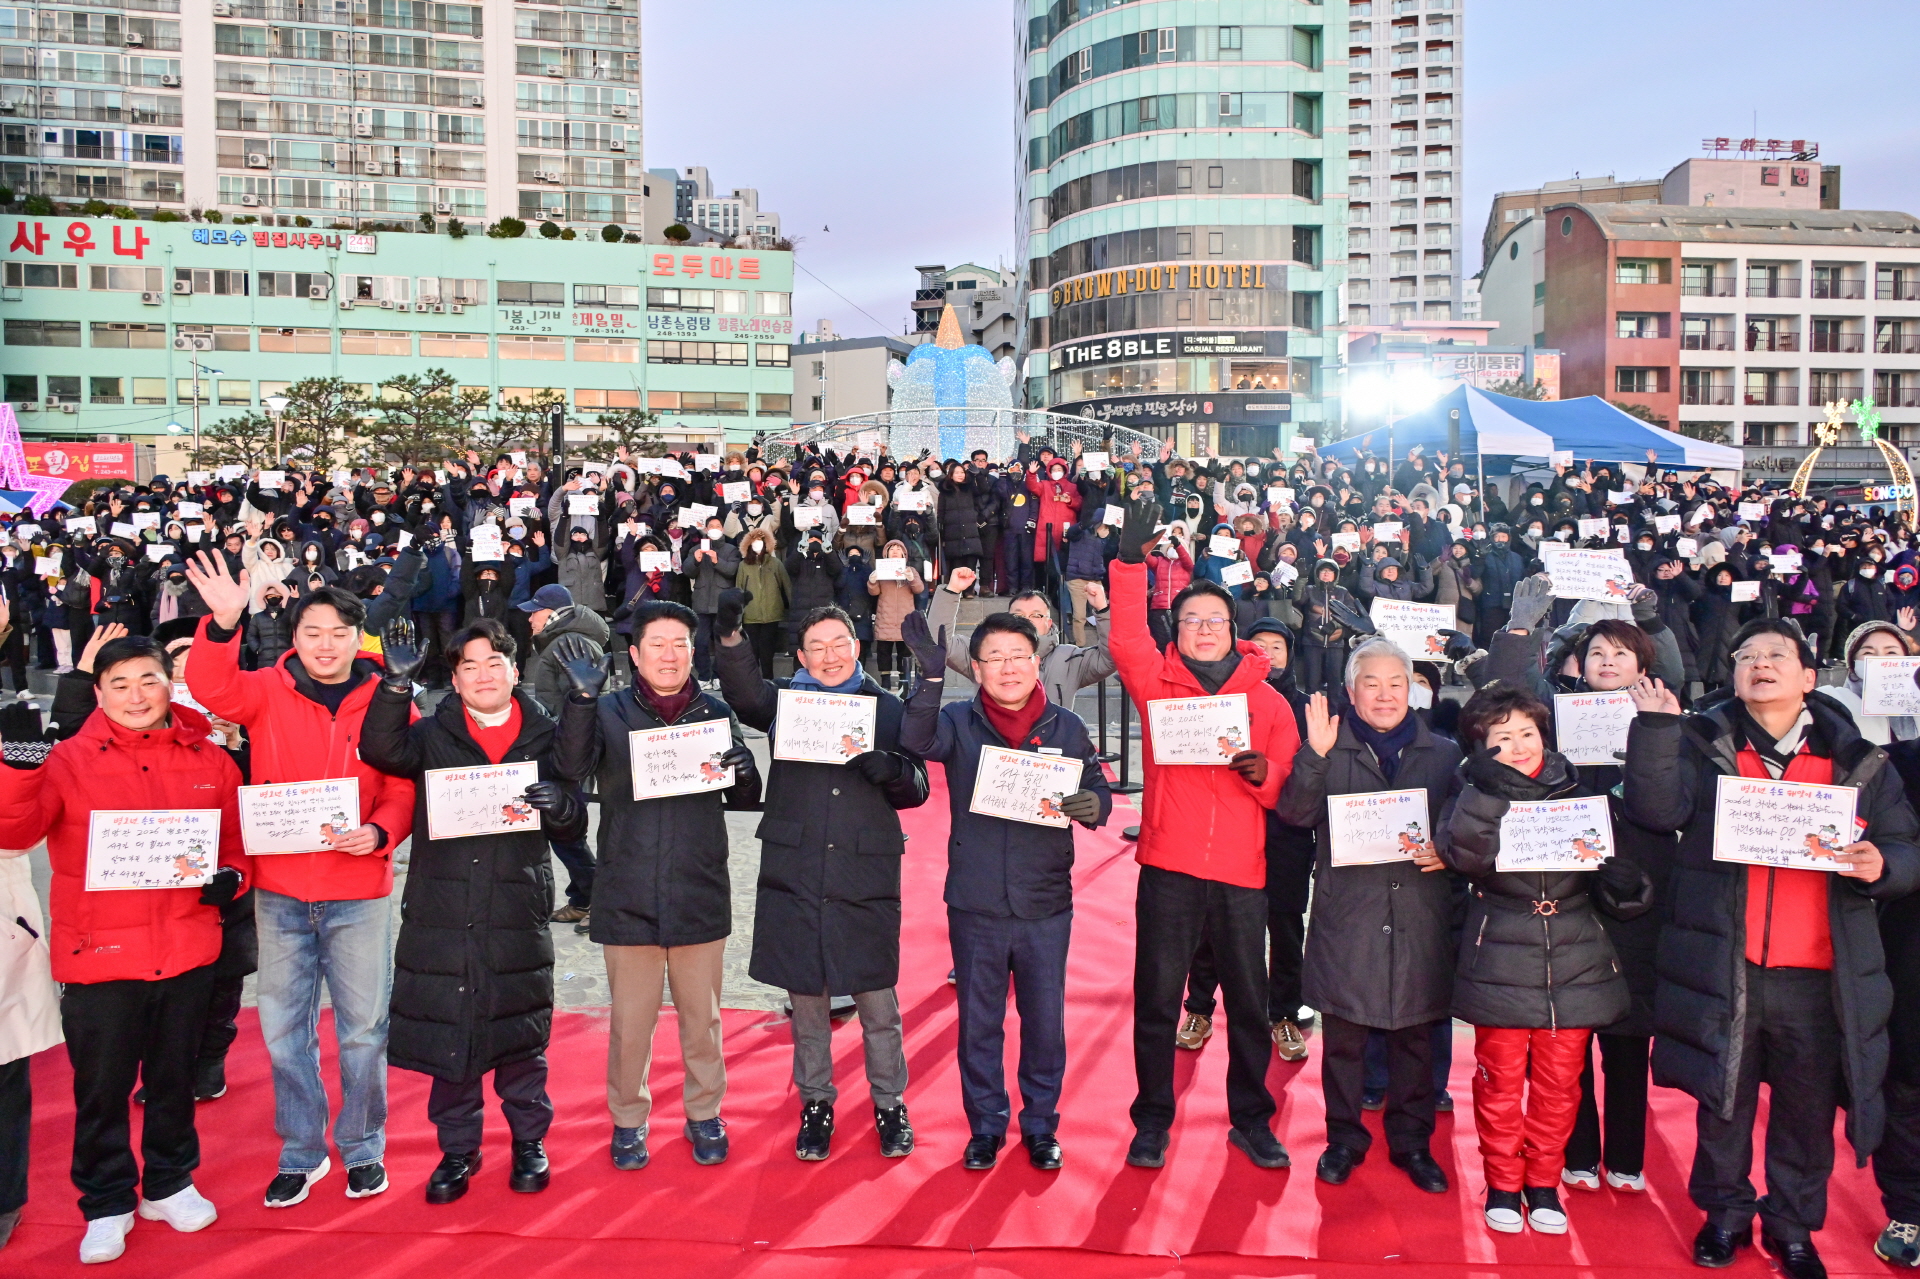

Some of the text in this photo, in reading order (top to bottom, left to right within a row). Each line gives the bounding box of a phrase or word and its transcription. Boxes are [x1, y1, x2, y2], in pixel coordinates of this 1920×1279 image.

[10, 221, 150, 260] 사우나
[192, 228, 373, 251] 해모수 찜질사우나 24시
[652, 253, 761, 279] 모두마트
[1188, 264, 1267, 289] HOTEL
[1066, 338, 1172, 364] THE 8BLE
[1184, 345, 1264, 353] CASUAL RESTAURANT
[173, 441, 191, 450] 송도
[816, 697, 827, 706] 송도
[848, 700, 861, 708] 축제
[1186, 702, 1197, 711] 송도
[1199, 701, 1218, 709] 해맞이
[1220, 700, 1232, 708] 축제
[1595, 697, 1606, 706] 송도
[1579, 707, 1624, 720] 2026
[669, 732, 681, 740] 송도
[682, 729, 700, 738] 해맞이
[703, 727, 715, 735] 축제
[1020, 758, 1031, 766] 송도
[1033, 761, 1051, 770] 해맞이
[1053, 764, 1066, 772] 축제
[469, 771, 481, 780] 송도
[483, 770, 503, 778] 해맞이
[505, 768, 519, 777] 축제
[285, 788, 298, 797] 송도
[300, 785, 322, 795] 해맞이
[324, 785, 339, 793] 축제
[1741, 785, 1833, 800] 병오년 송도 해맞이 축제
[1367, 798, 1378, 806] 송도
[1379, 797, 1397, 805] 해맞이
[1535, 805, 1547, 813] 송도
[1549, 804, 1571, 812] 해맞이
[1573, 803, 1588, 811] 축제
[113, 815, 199, 826] 병오년 송도 해맞이 축제
[136, 826, 160, 837] 2026
